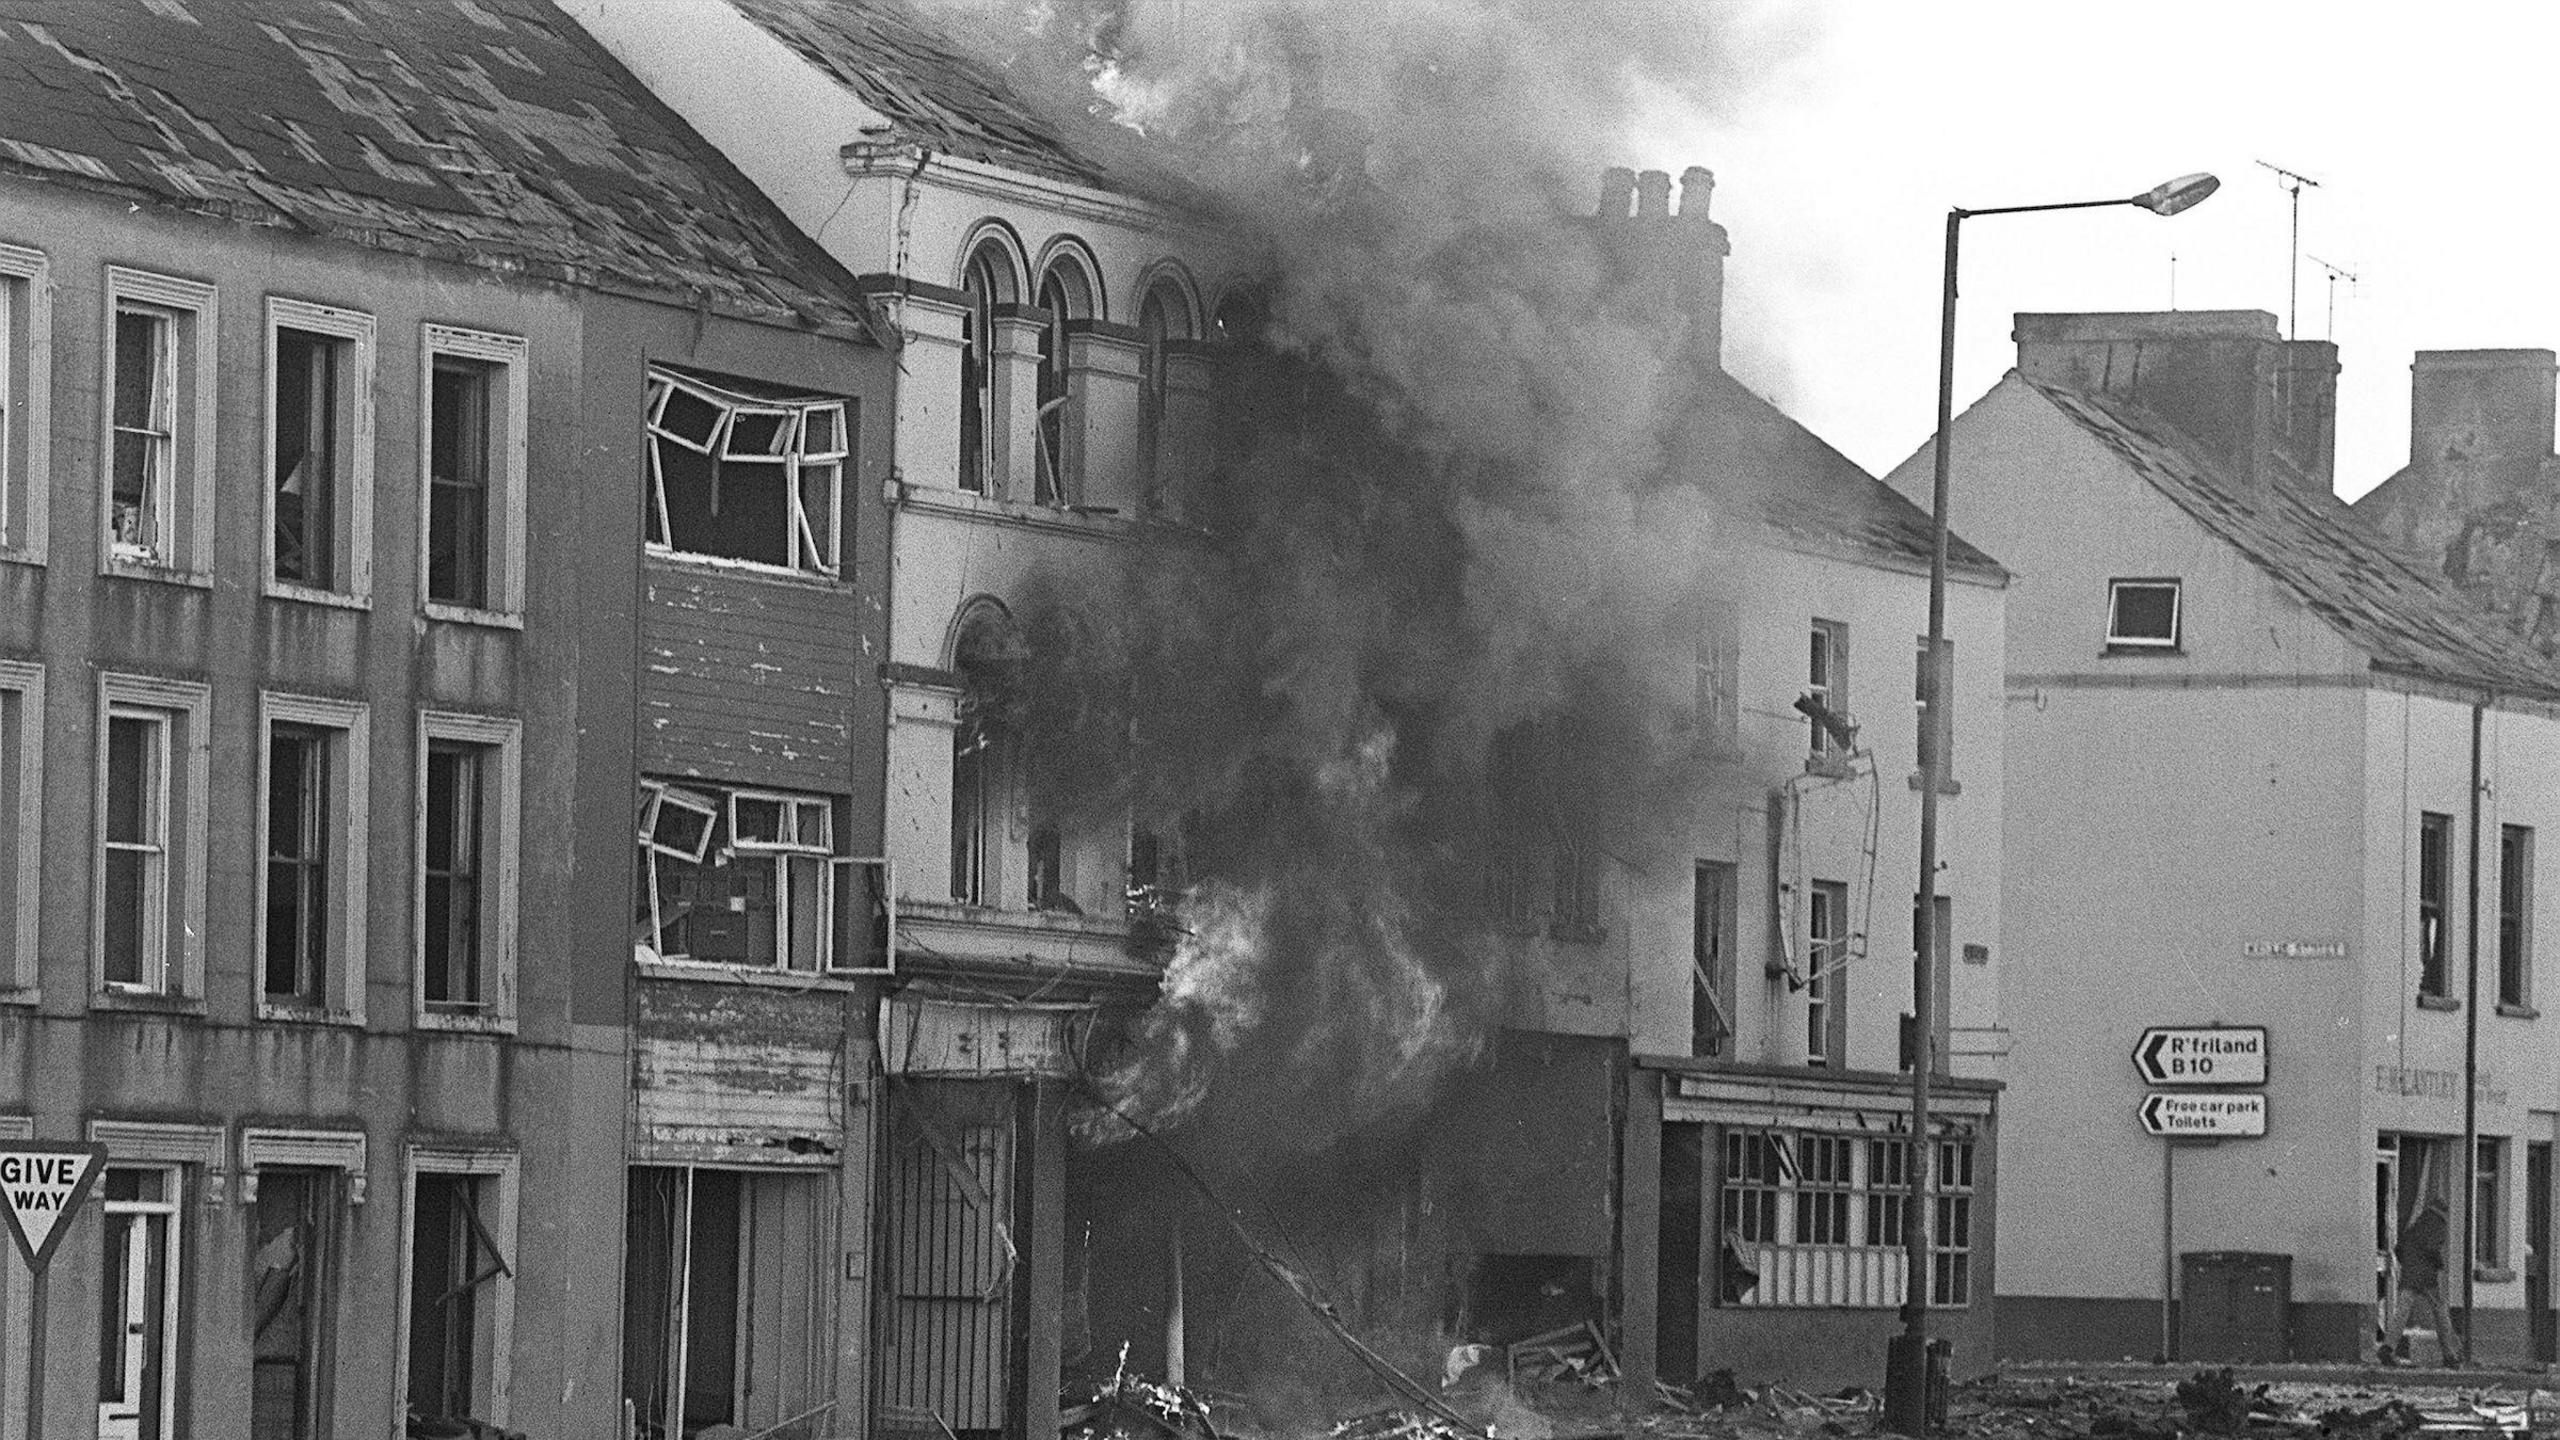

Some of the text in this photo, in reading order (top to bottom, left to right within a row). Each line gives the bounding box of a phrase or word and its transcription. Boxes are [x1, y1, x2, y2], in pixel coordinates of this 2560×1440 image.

[2171, 1037, 2258, 1054] R'friland
[2166, 1100, 2260, 1114] Free car park
[2167, 1115, 2216, 1128] Toilets
[0, 1157, 75, 1185] GIVE
[14, 1191, 65, 1210] WAY
